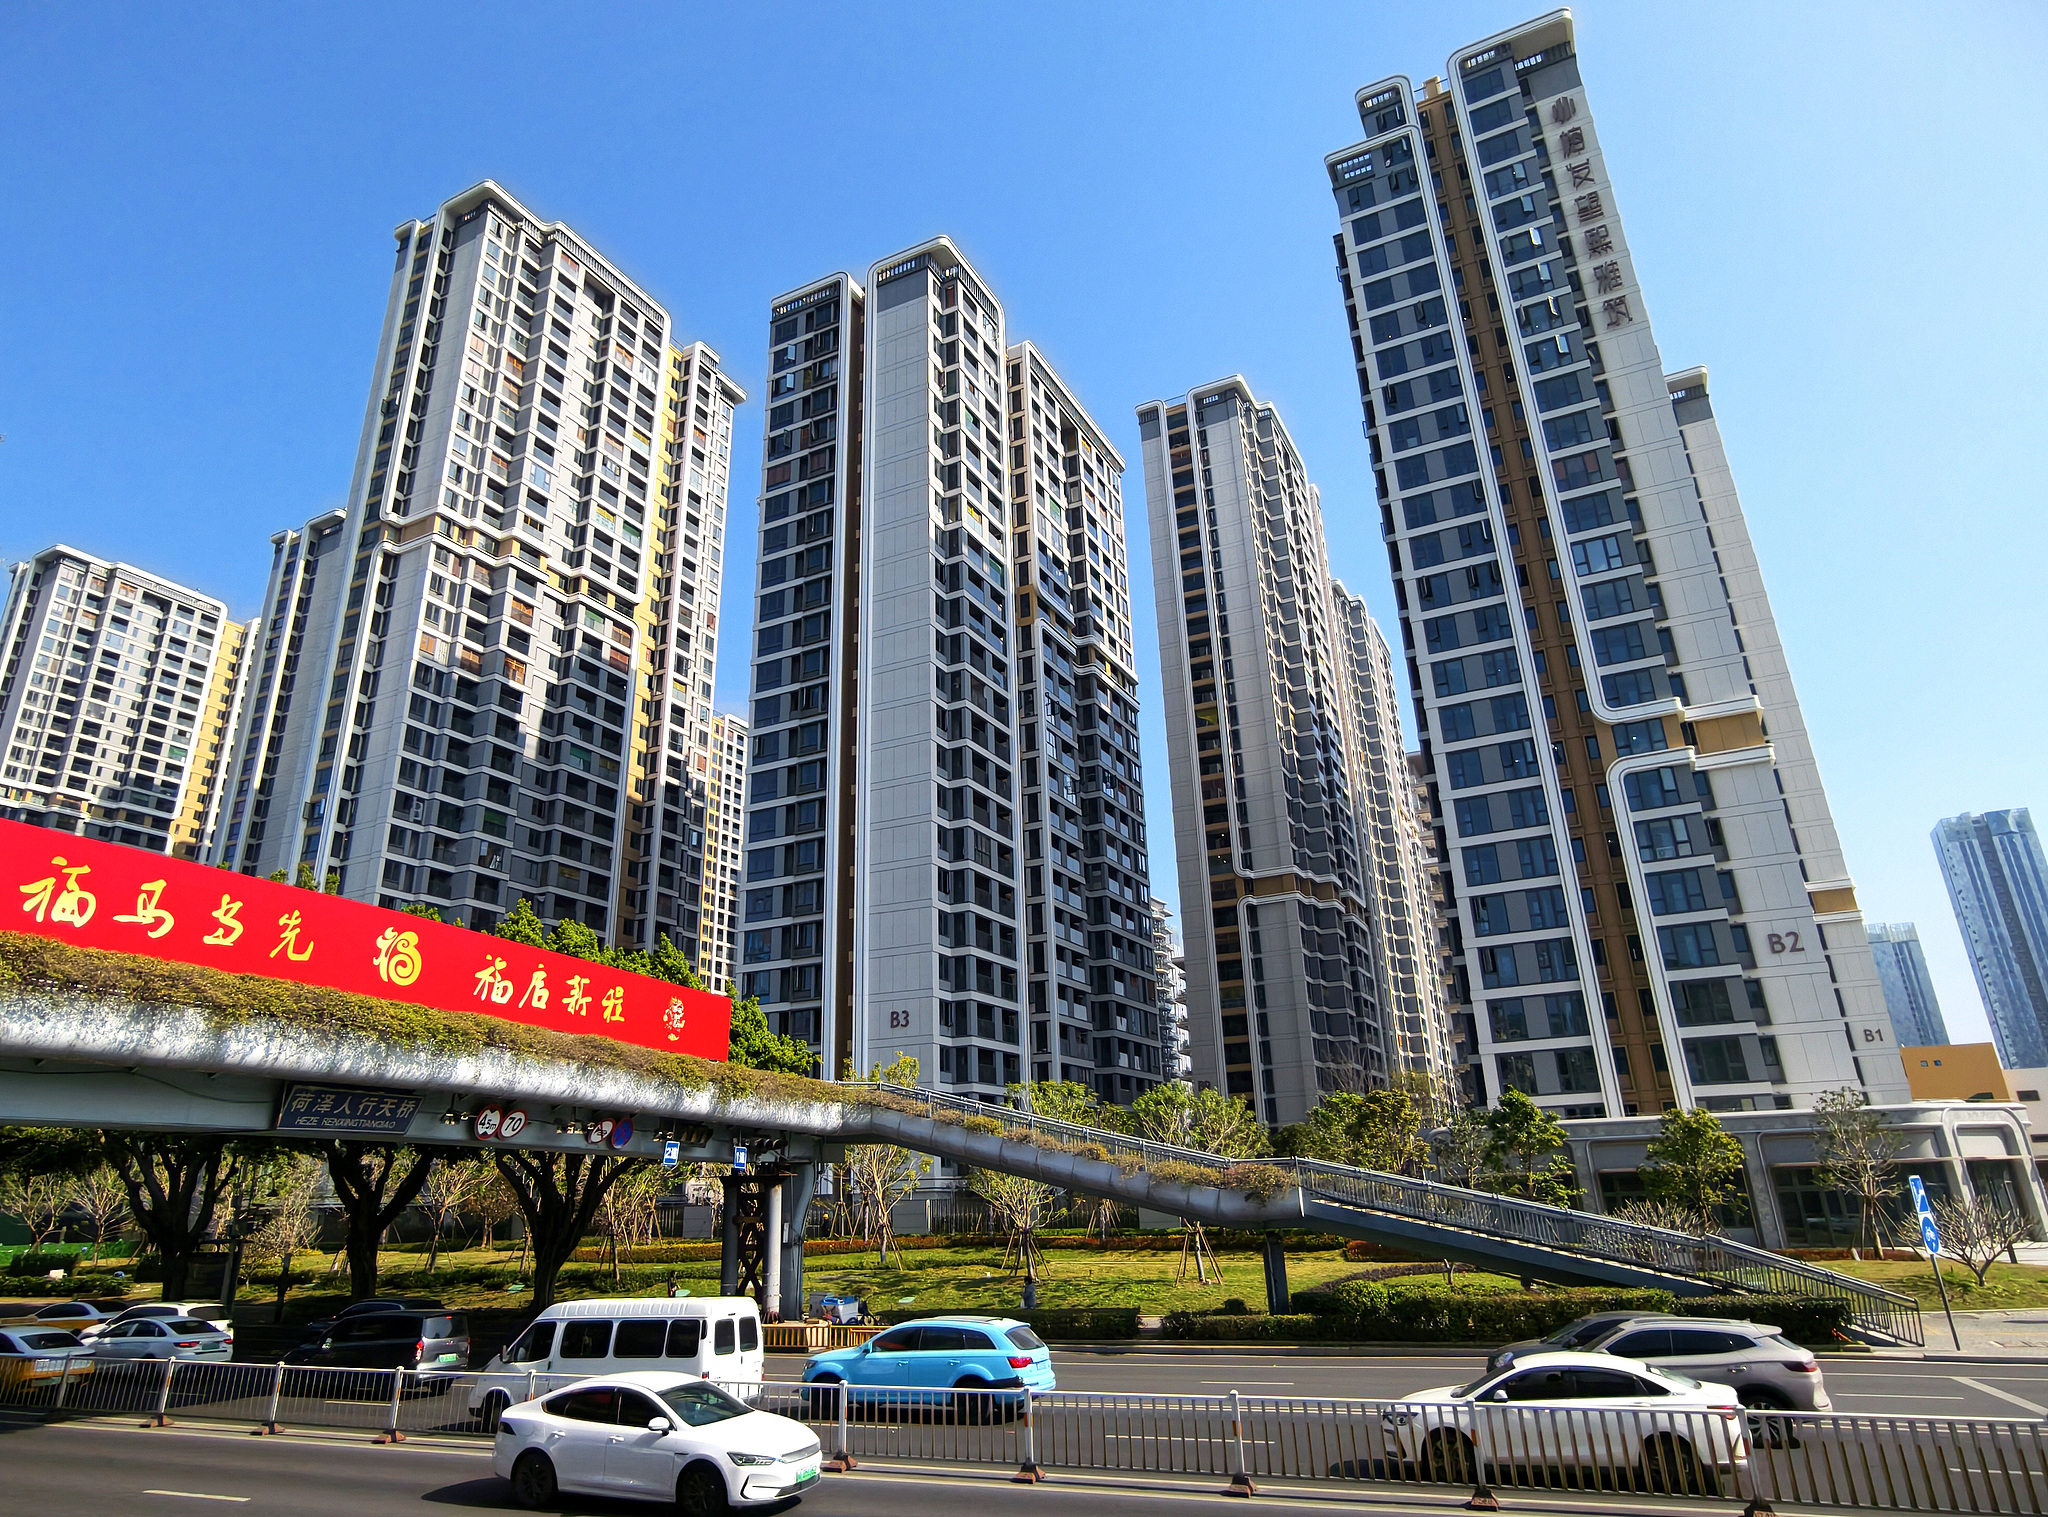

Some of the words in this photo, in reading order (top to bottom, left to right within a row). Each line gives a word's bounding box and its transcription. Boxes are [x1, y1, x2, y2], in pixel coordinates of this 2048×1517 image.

[1767, 931, 1805, 954] B2
[890, 1010, 910, 1029] B3
[1863, 1029, 1884, 1043] B1
[291, 1092, 416, 1119] 荷泽人行天桥
[295, 1116, 320, 1126] HEZE
[505, 1117, 523, 1132] 70
